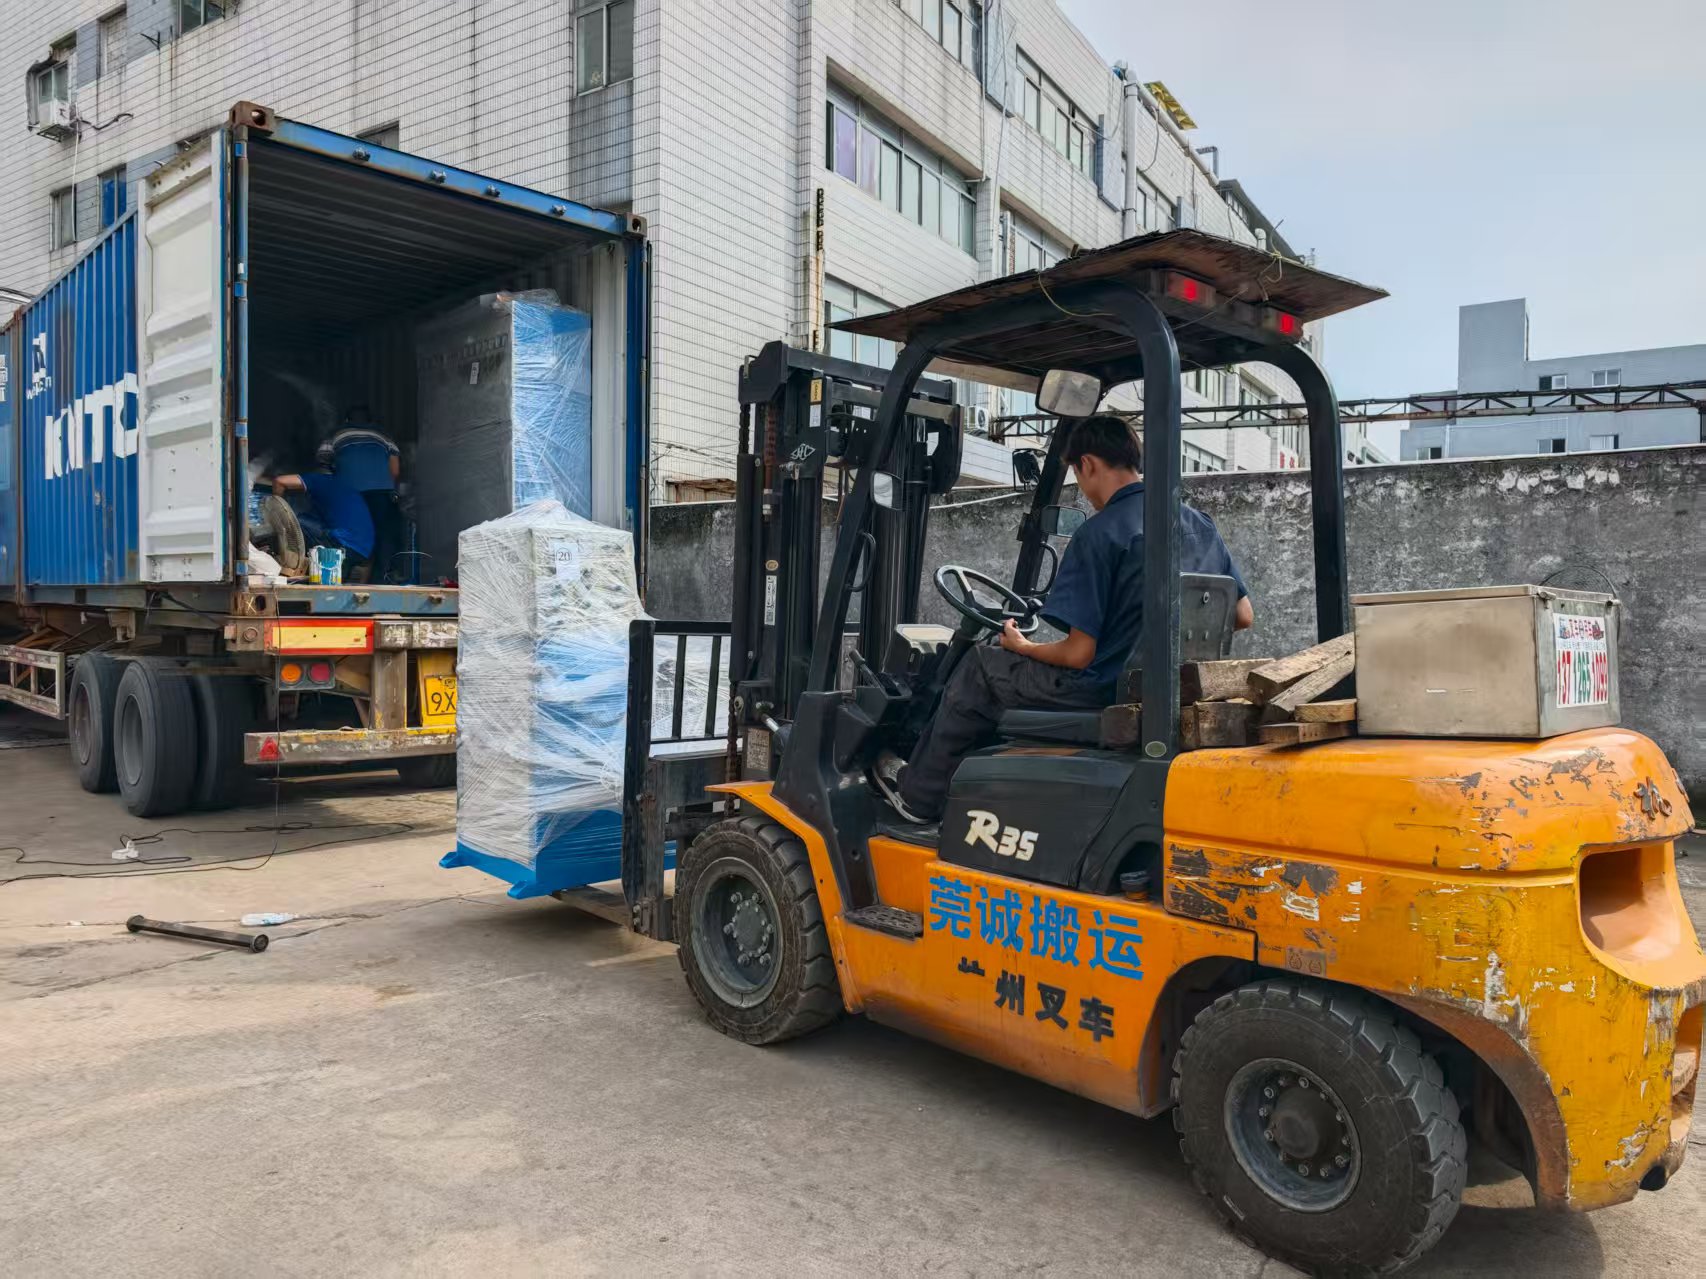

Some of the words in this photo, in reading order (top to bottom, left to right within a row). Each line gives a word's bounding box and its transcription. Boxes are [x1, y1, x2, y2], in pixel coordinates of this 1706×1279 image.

[1557, 650, 1571, 705] 137
[965, 810, 1039, 861] R35
[929, 876, 1144, 980] 莞诚搬运
